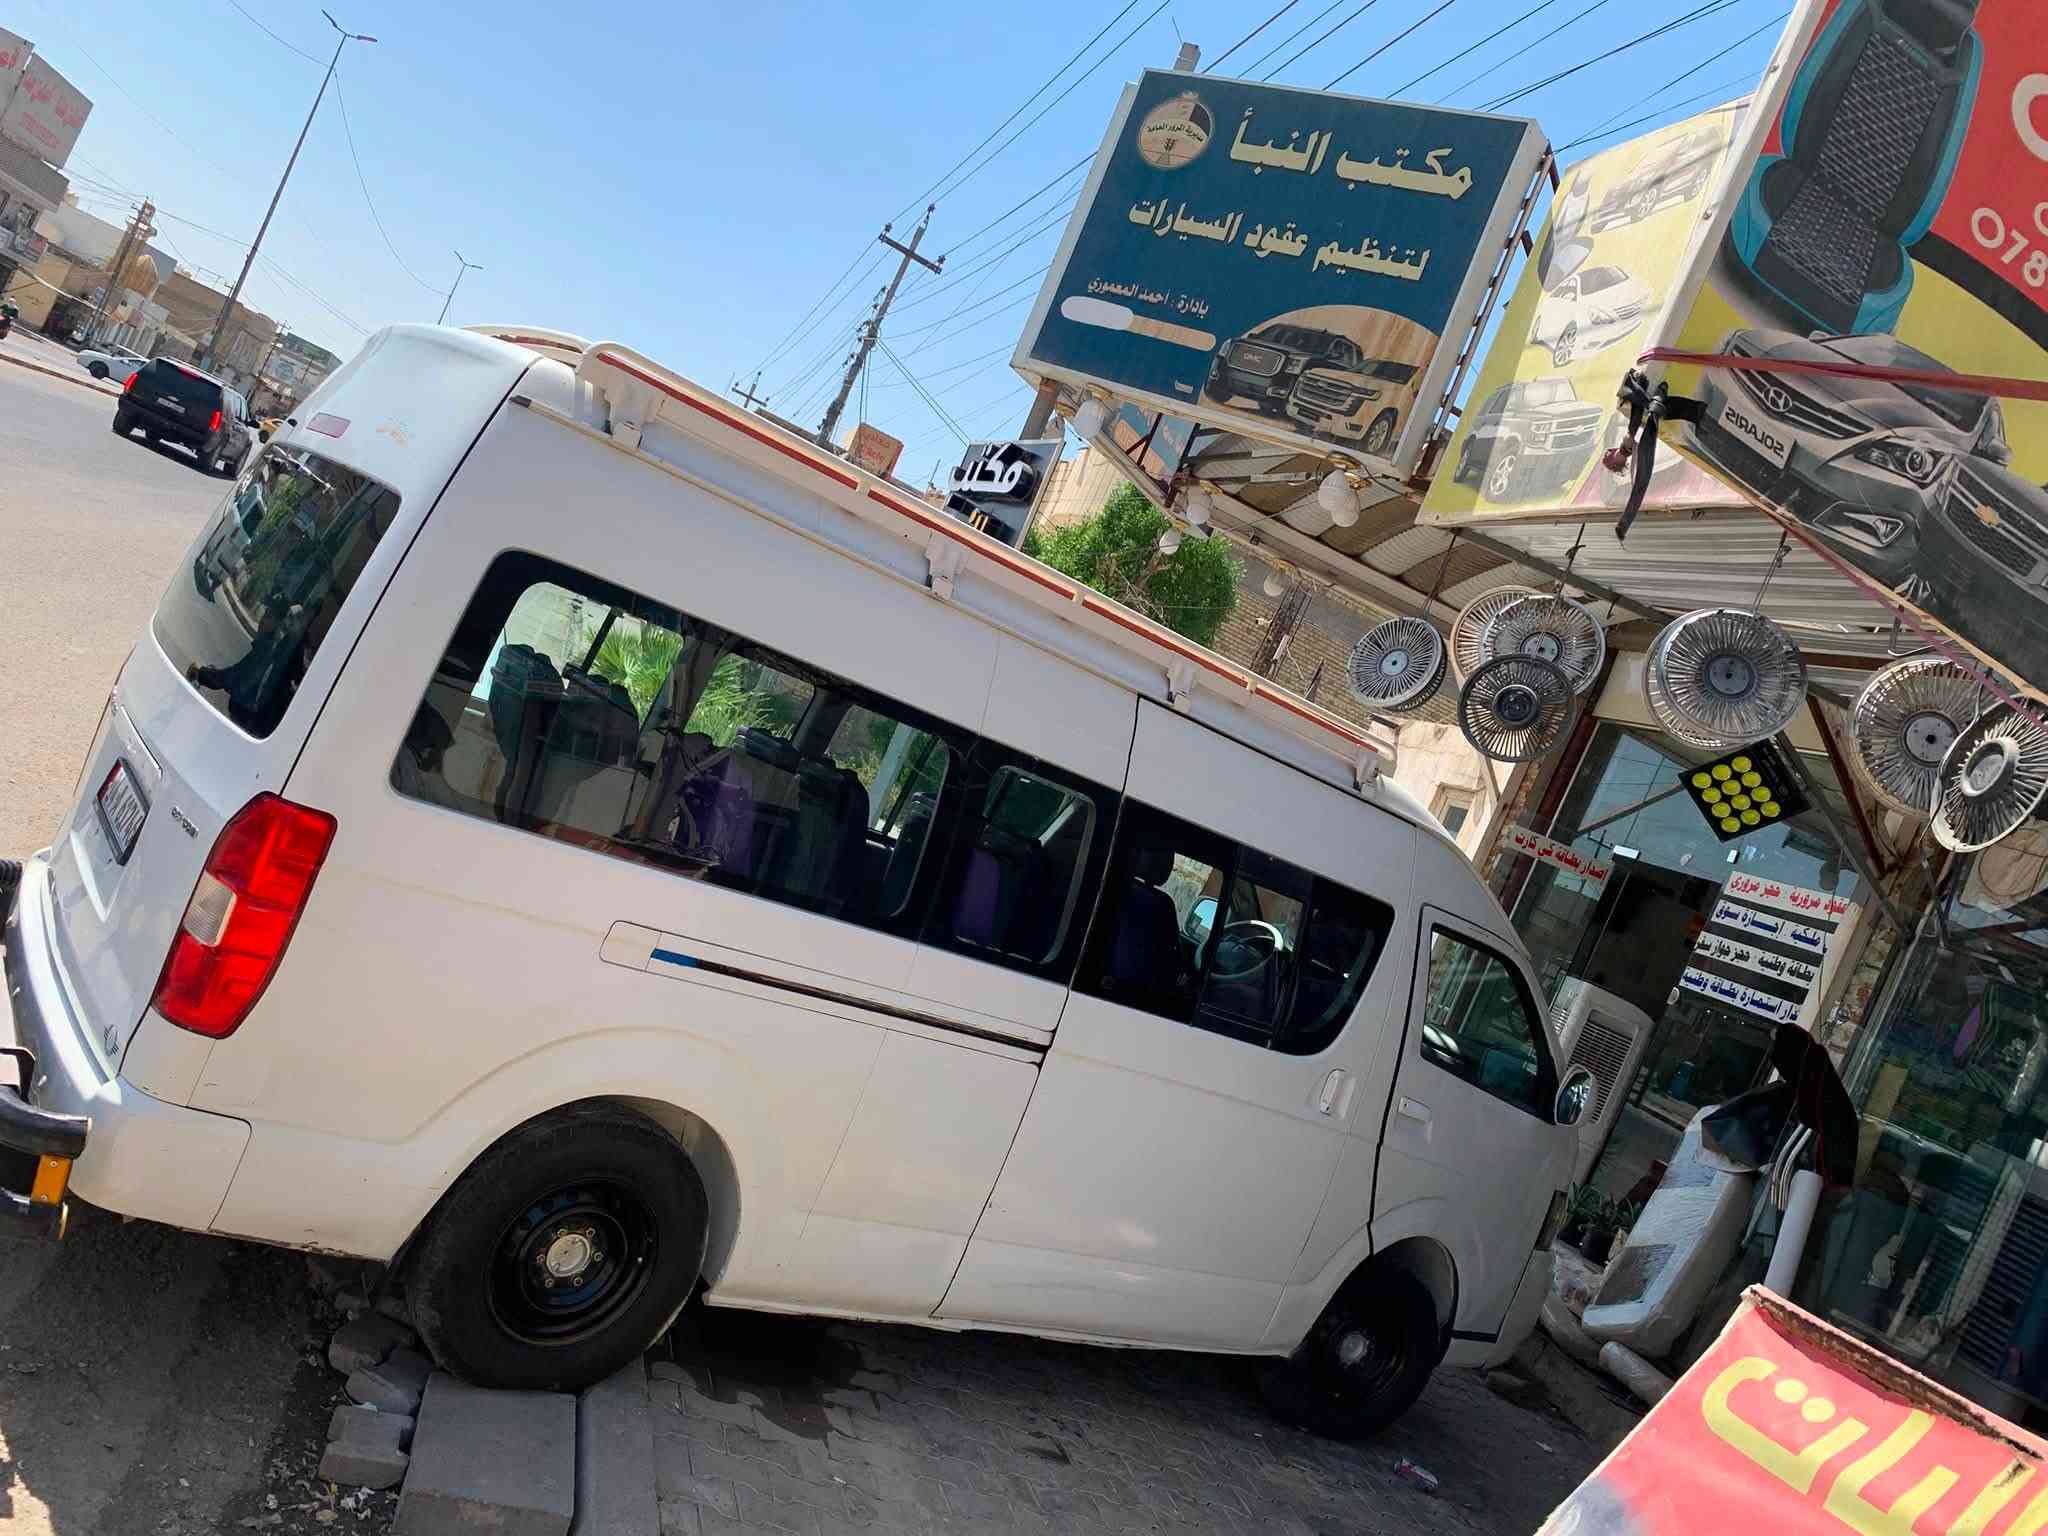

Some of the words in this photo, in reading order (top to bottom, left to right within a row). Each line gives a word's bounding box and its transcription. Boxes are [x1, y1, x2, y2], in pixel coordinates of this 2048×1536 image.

[1230, 106, 1333, 175] النبأ
[1336, 147, 1473, 199] مكتب
[1129, 198, 1244, 244] السيارات
[1244, 221, 1308, 257] عقود
[1312, 237, 1431, 280] لتنظيم
